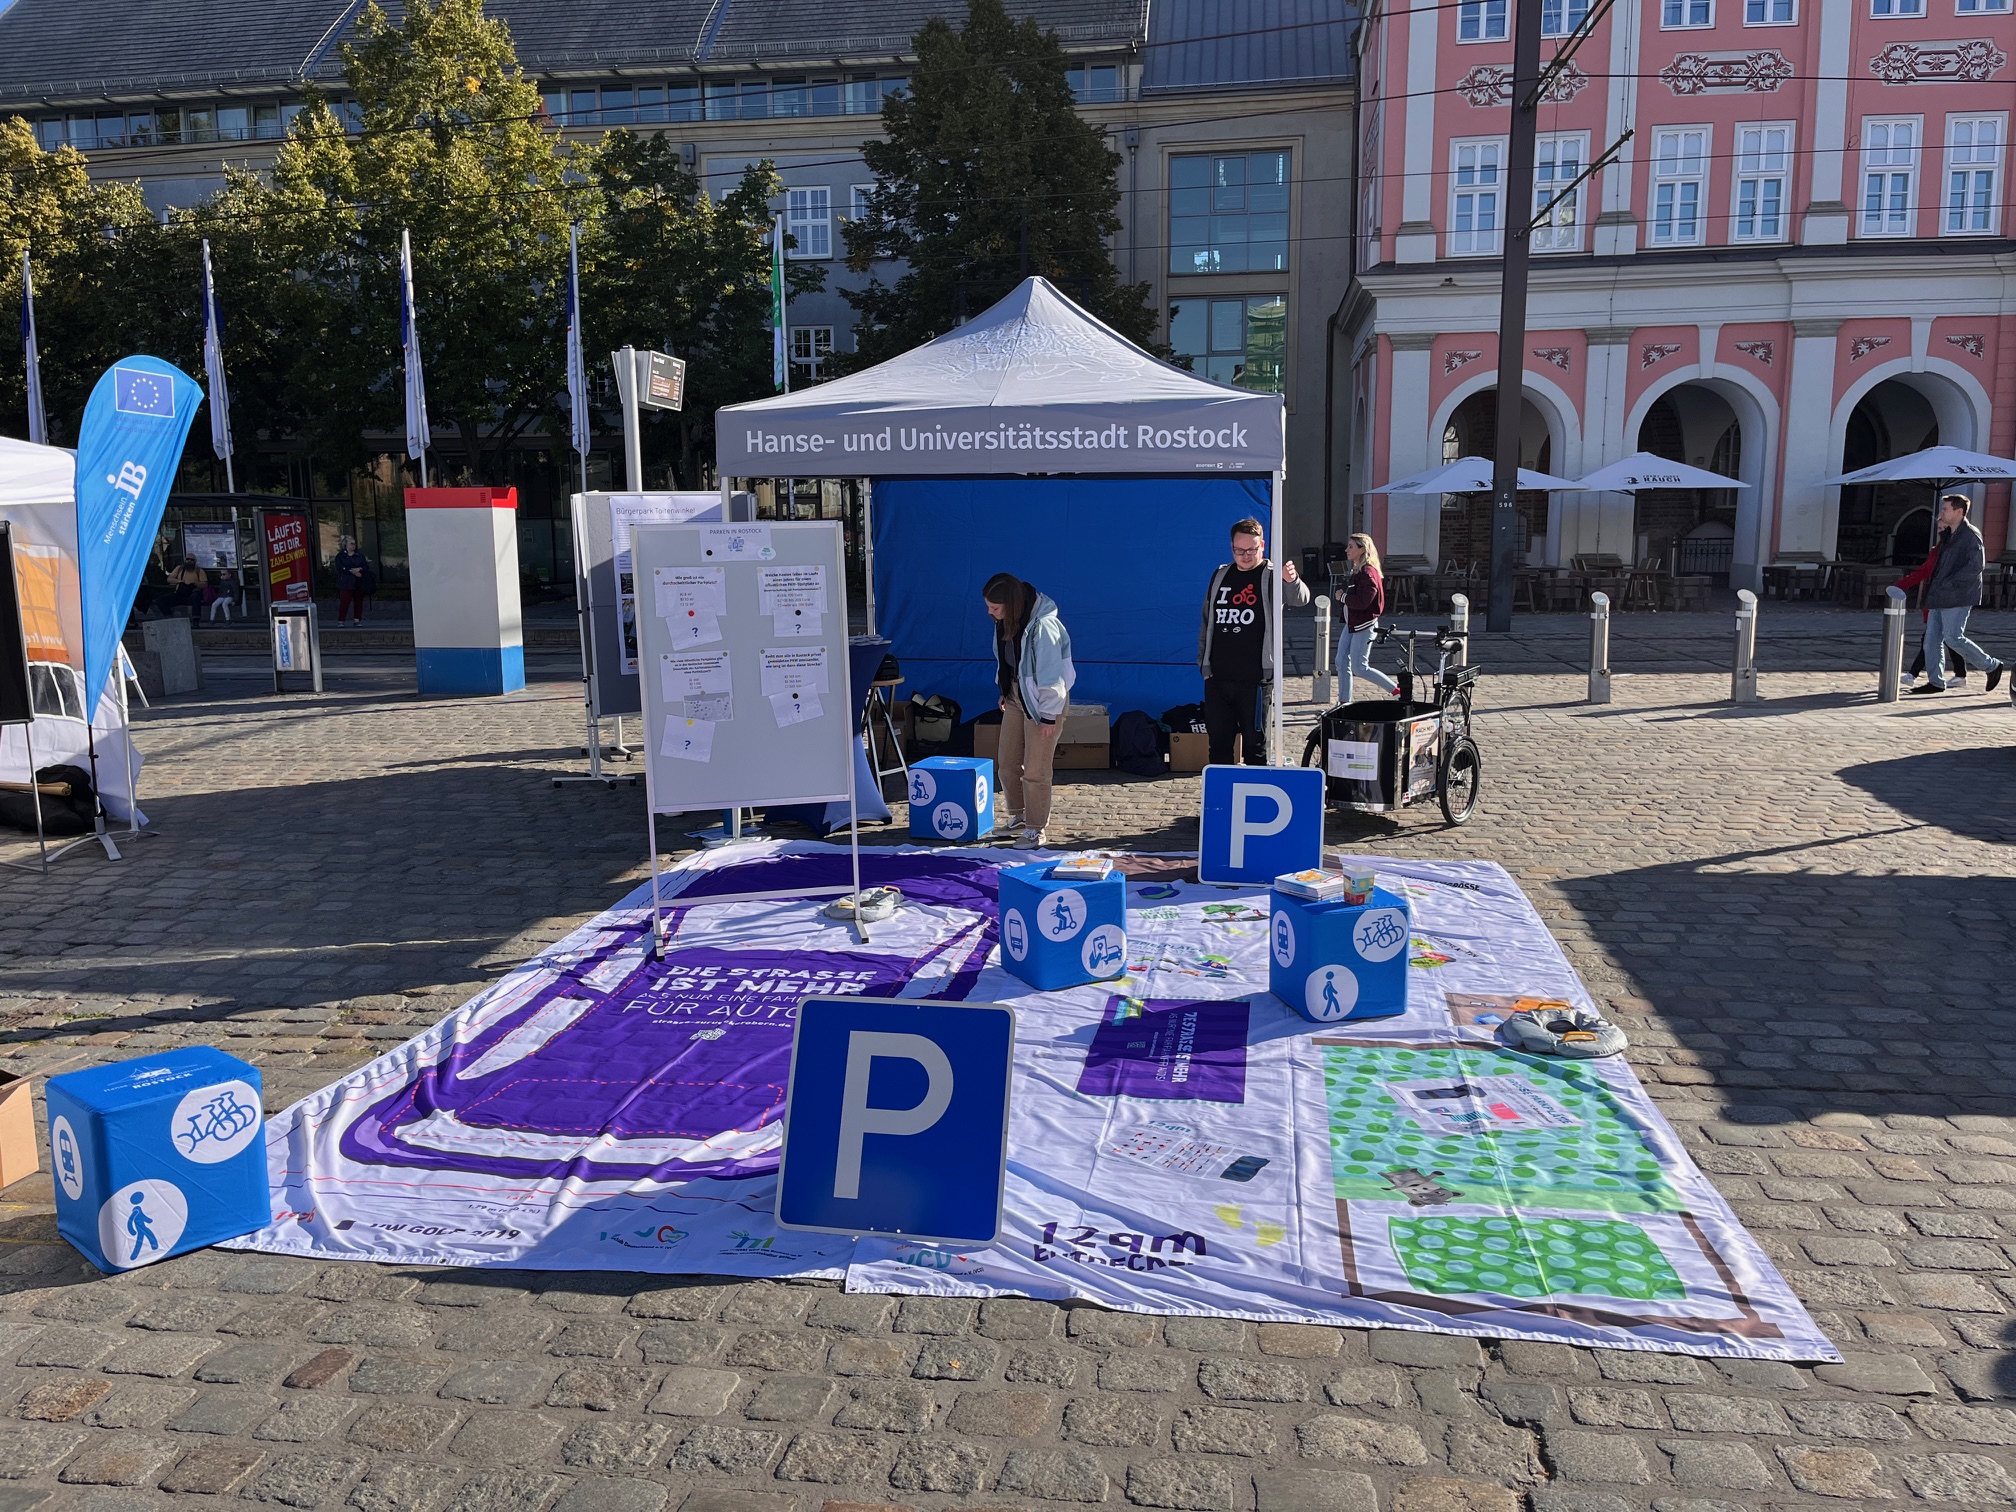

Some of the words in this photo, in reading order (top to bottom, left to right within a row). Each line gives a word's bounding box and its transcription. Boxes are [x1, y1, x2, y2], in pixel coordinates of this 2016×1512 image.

[746, 429, 836, 454] Hanse-
[843, 427, 891, 452] und
[900, 424, 1128, 452] Universitätsstadt
[1136, 422, 1248, 449] Rostock
[118, 502, 136, 536] stärken
[616, 508, 654, 516] Bürgerpark
[104, 497, 127, 544] Menschsein
[274, 541, 287, 554] BEI
[270, 552, 294, 568] ZAHLEN
[294, 548, 306, 560] WIR!
[1216, 587, 1232, 604] I
[1216, 608, 1255, 625] HRO
[692, 627, 698, 637] ?
[795, 624, 801, 634] ?
[794, 704, 800, 713] ?
[685, 740, 691, 750] ?
[1229, 782, 1292, 869] P
[667, 966, 722, 976] DIE
[728, 968, 877, 981] STRASSE
[650, 978, 728, 992] IST
[622, 1000, 700, 1016] FÜR
[132, 1073, 193, 1089] ROSTOCK
[833, 1031, 953, 1200] P
[1038, 1222, 1206, 1256] 12qm
